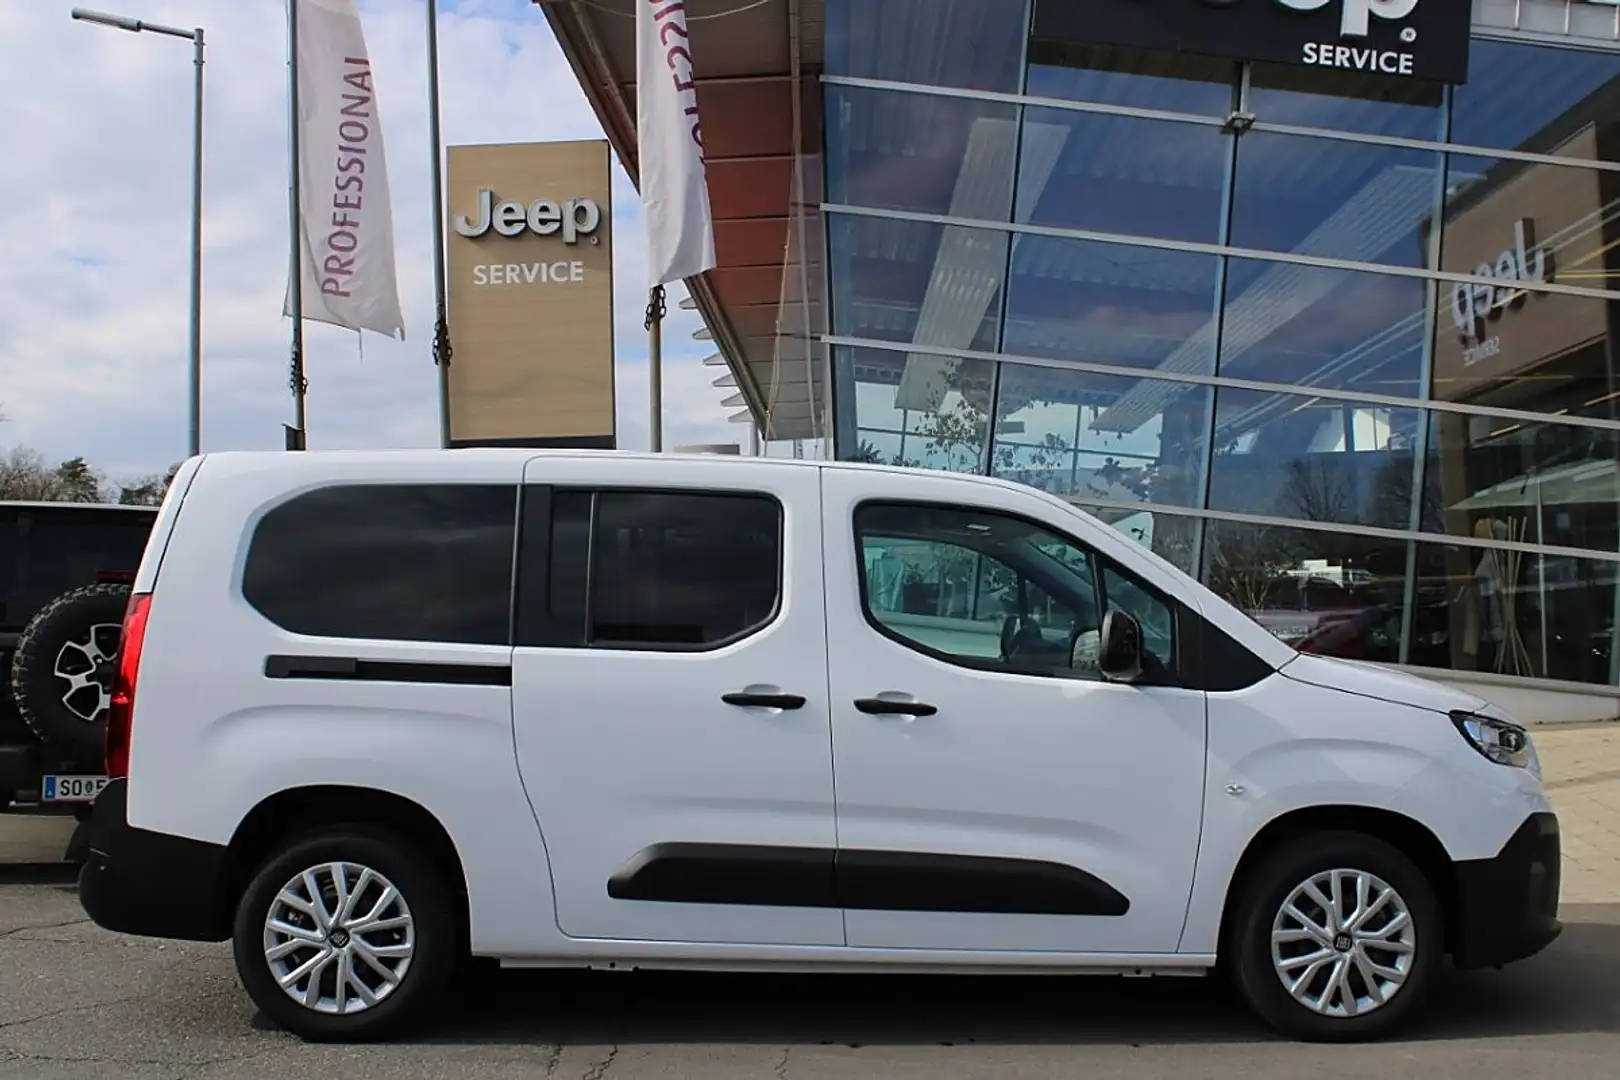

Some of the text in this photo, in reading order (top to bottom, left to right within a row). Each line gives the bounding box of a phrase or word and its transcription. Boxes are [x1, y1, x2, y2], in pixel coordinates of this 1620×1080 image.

[1302, 42, 1414, 75] SERVICE
[454, 188, 600, 244] Jeep
[473, 260, 584, 285] SERVICE
[60, 779, 83, 796] SO
